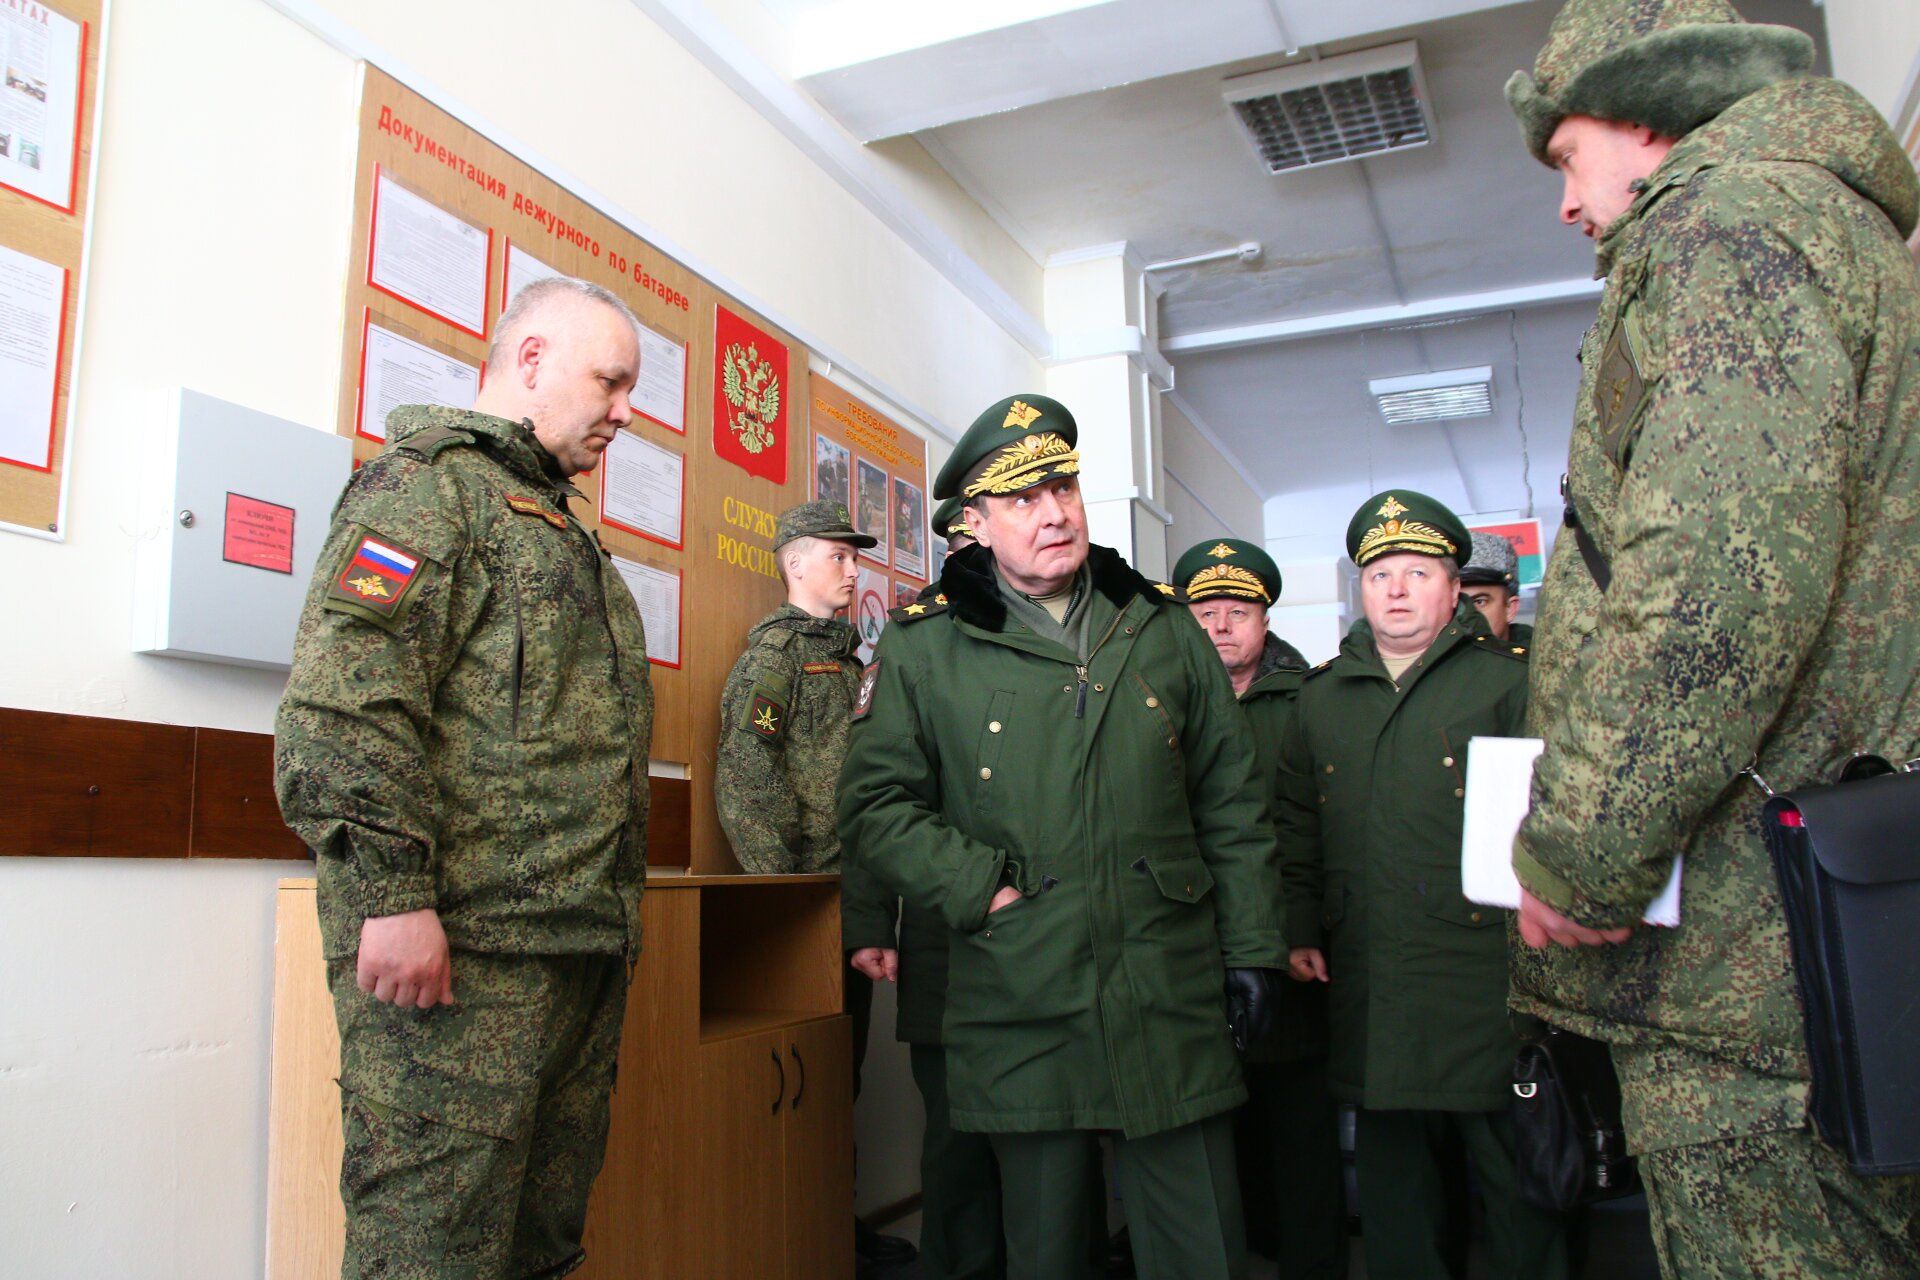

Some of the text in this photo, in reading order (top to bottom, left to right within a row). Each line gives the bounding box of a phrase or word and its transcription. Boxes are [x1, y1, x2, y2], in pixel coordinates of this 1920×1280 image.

[378, 104, 507, 200] Документация
[512, 191, 600, 257] дежурного
[608, 251, 627, 274] по
[633, 263, 689, 311] батарее
[847, 402, 897, 440] ТРЕБОВАНИЯ
[723, 496, 779, 540] СЛУЖУ
